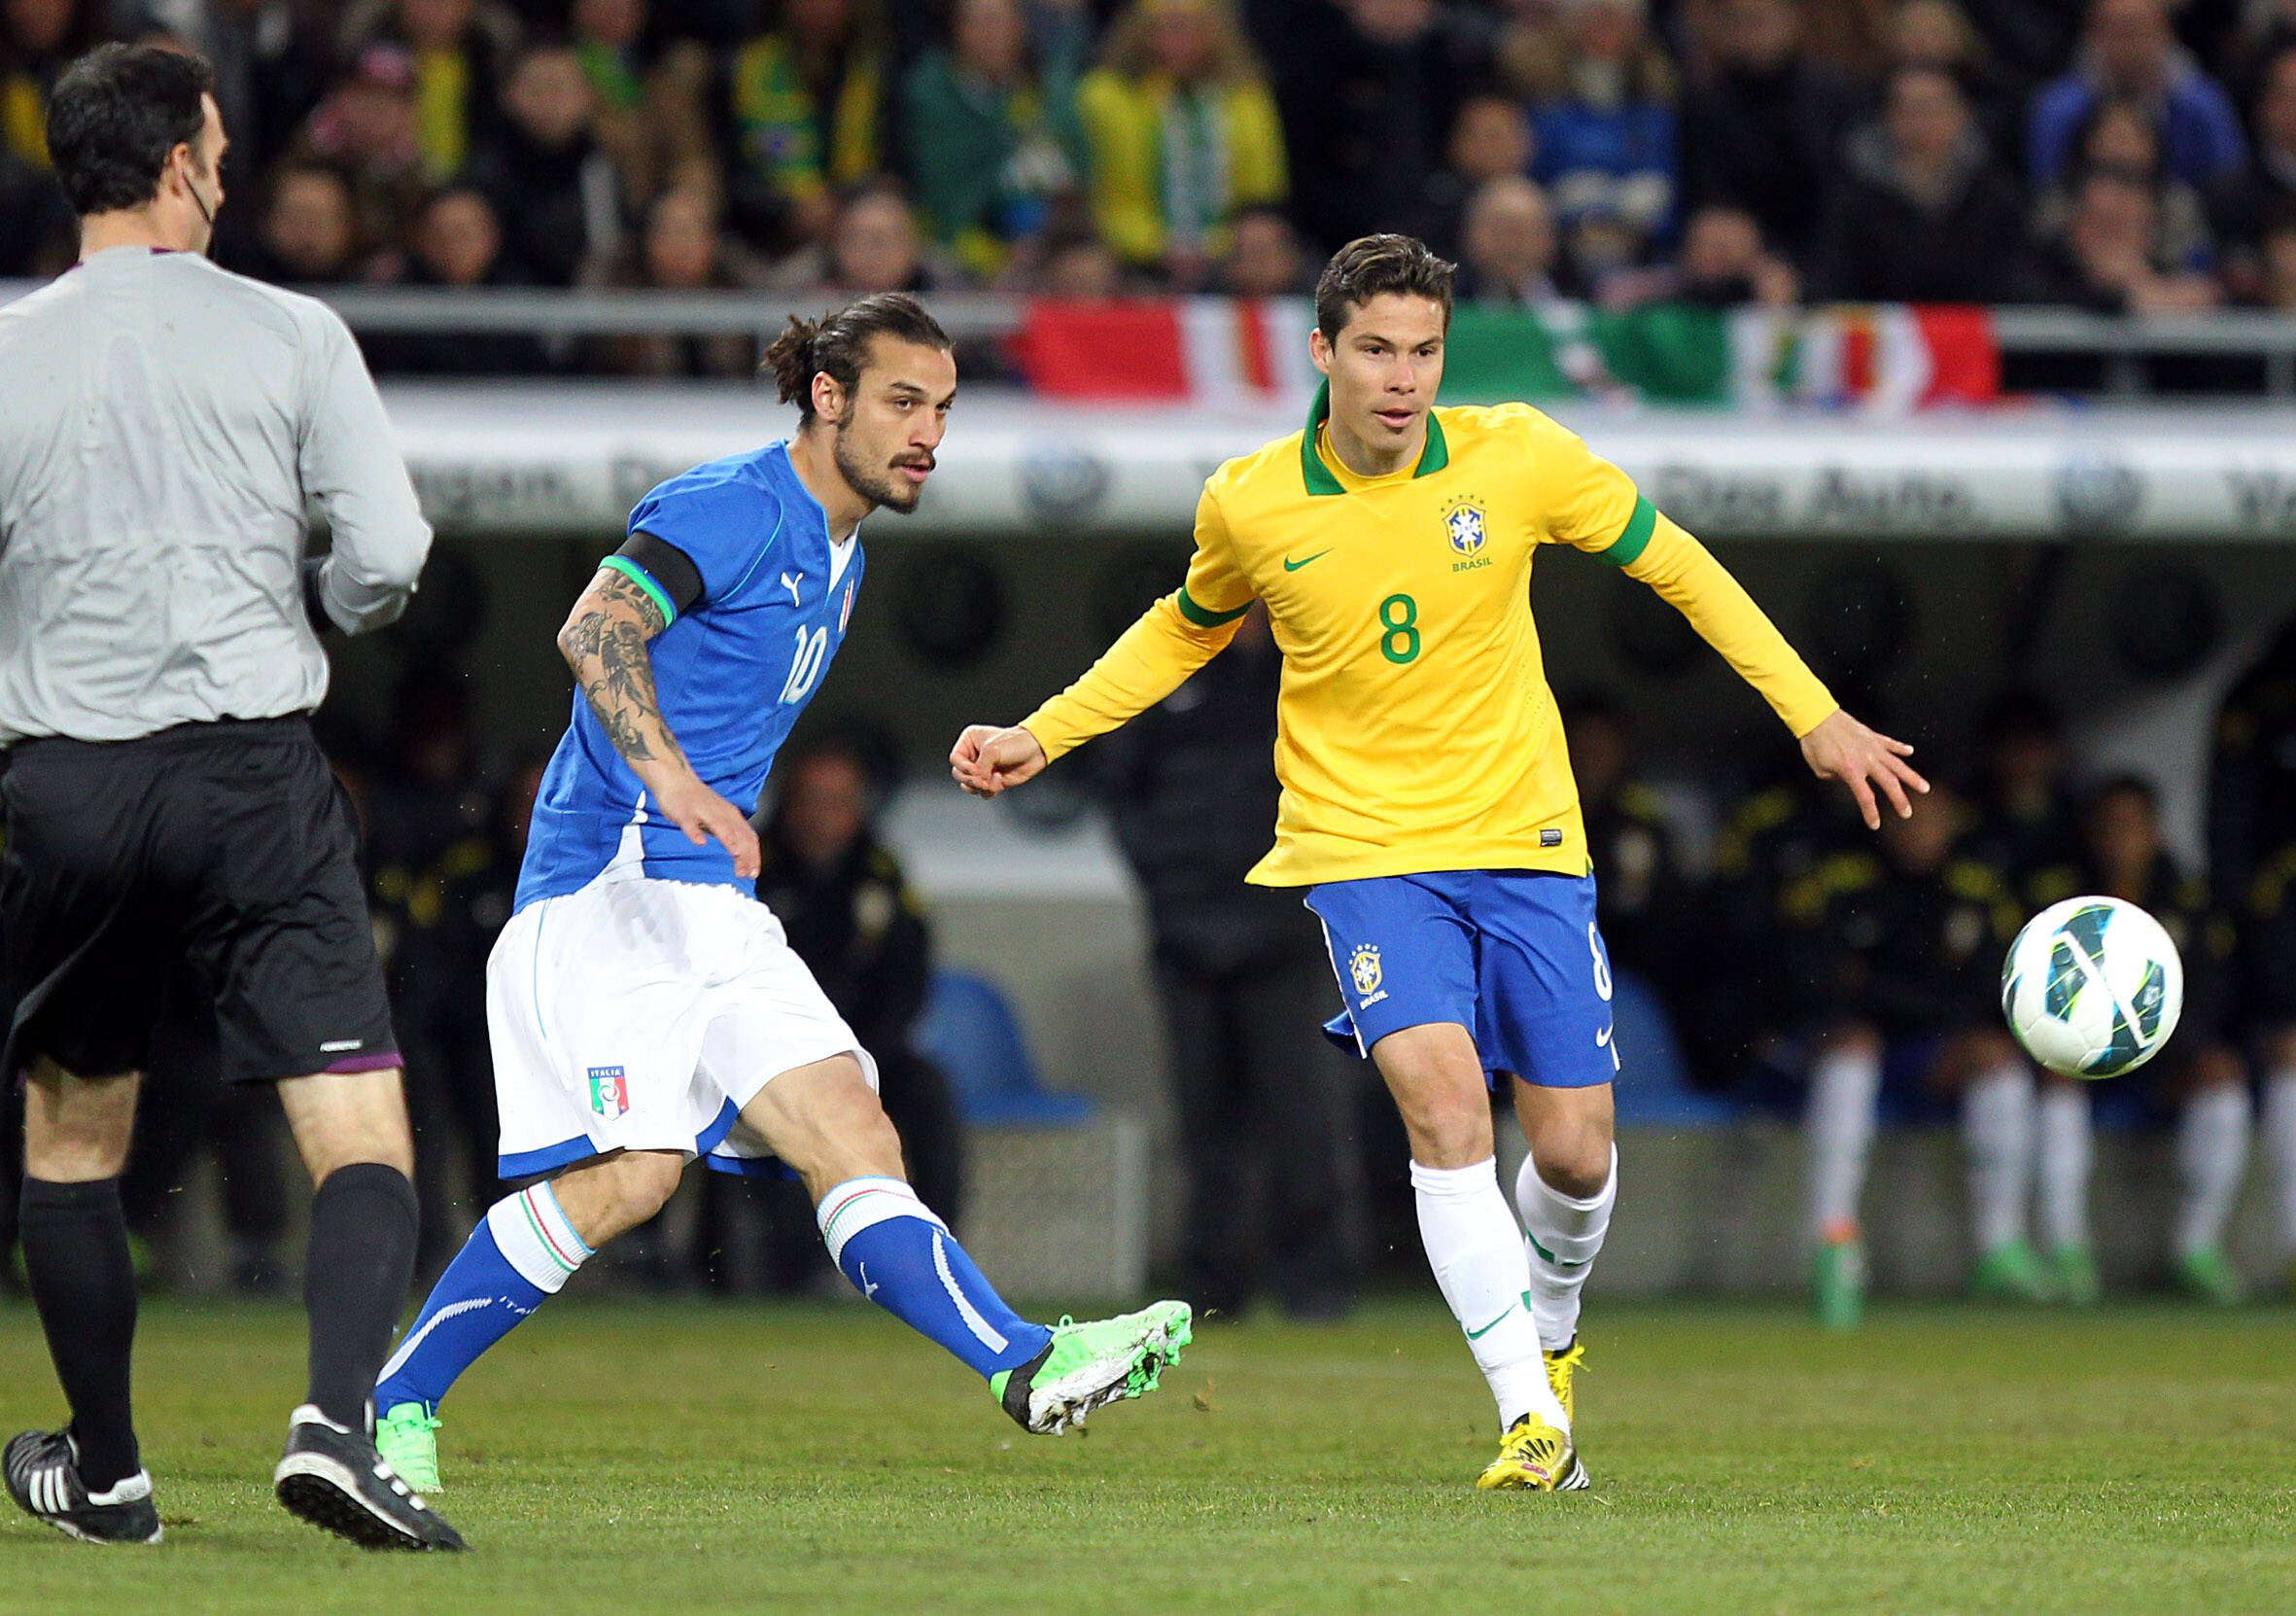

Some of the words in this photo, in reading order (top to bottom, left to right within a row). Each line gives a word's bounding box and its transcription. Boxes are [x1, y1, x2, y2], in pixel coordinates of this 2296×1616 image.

[1452, 557, 1493, 572] BRASIL
[1379, 593, 1420, 664] 8
[778, 623, 827, 705] 10
[590, 1069, 622, 1077] ITALIA
